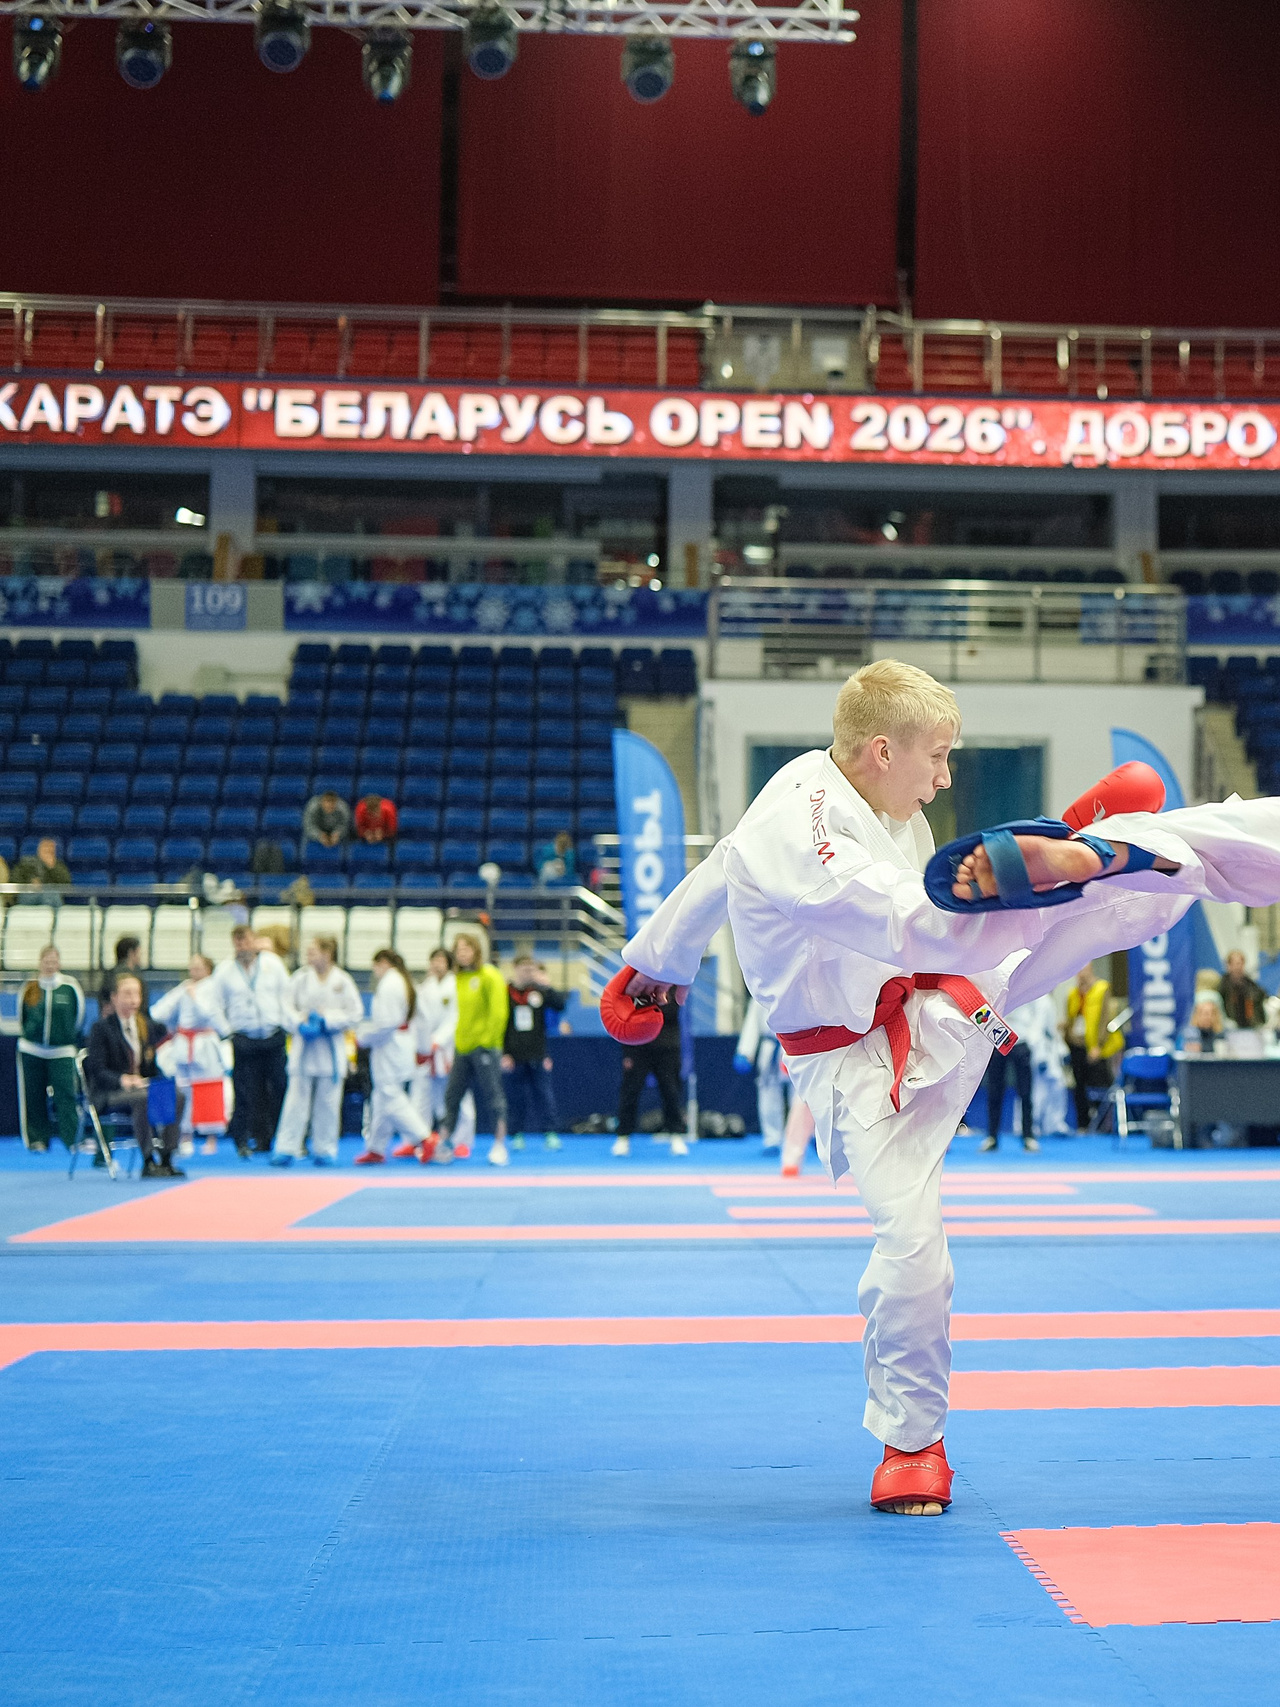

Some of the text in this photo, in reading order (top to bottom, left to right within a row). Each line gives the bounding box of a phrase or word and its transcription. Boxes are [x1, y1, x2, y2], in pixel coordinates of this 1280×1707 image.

[243, 388, 633, 444] "БЕЛАРУСЬ
[649, 397, 833, 450] OPEN
[1061, 409, 1277, 463] ДОБРО
[189, 583, 242, 615] 109
[809, 788, 835, 865] WESING
